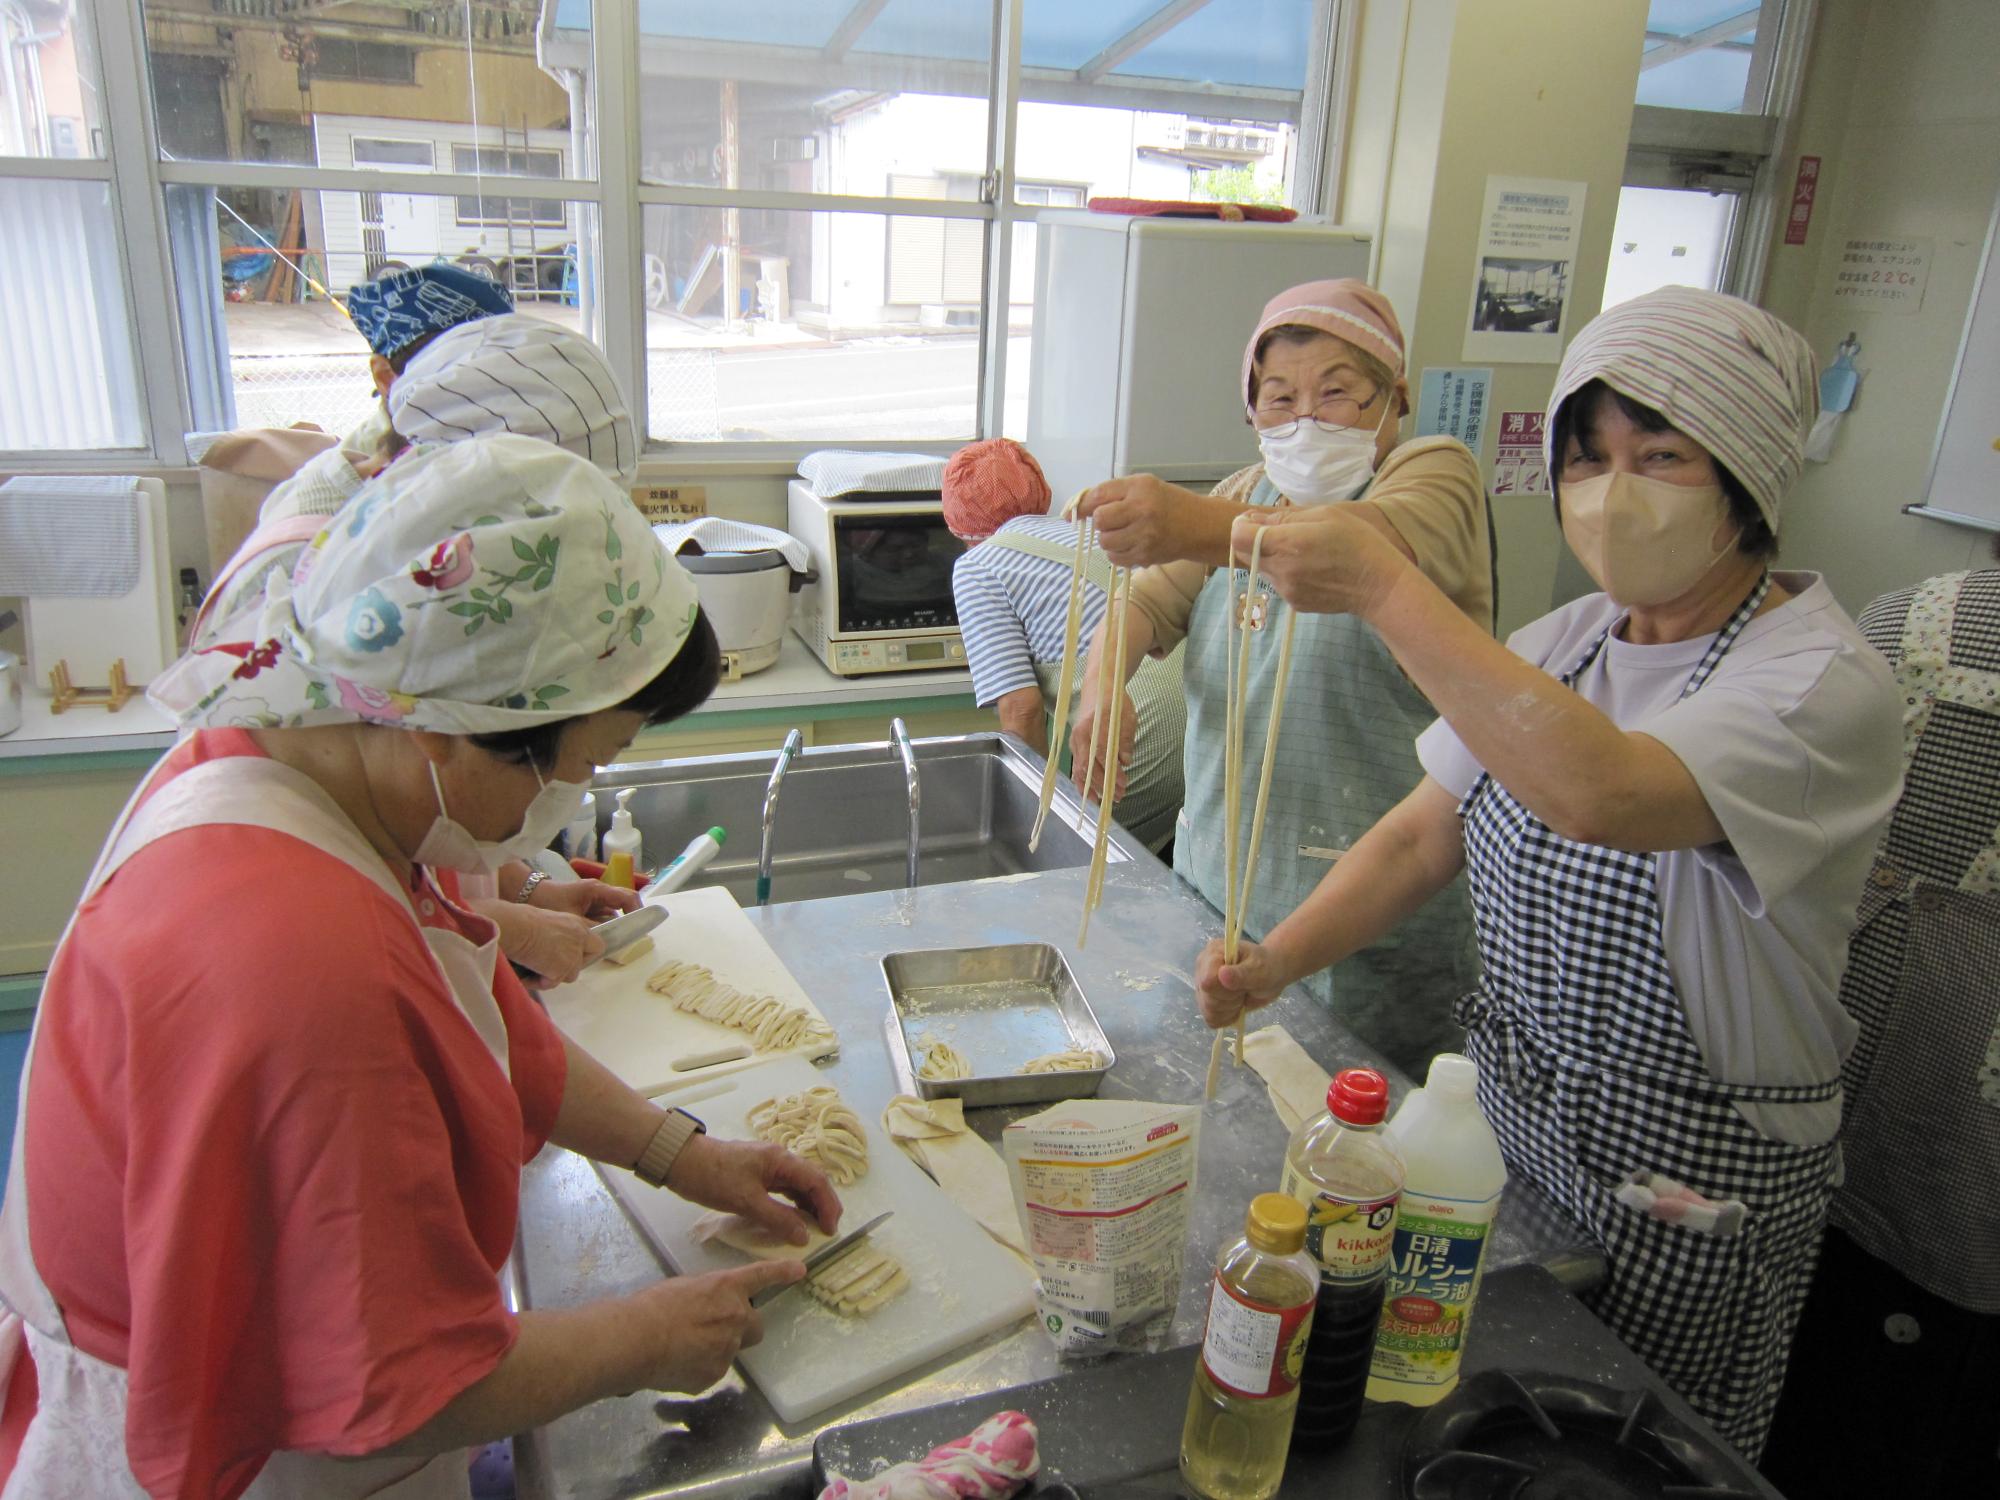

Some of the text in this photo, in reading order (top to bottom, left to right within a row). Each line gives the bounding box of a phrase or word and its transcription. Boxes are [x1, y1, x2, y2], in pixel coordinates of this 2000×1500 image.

[1409, 1233, 1452, 1256] 日清
[1388, 1276, 1470, 1300] ャノーラ油
